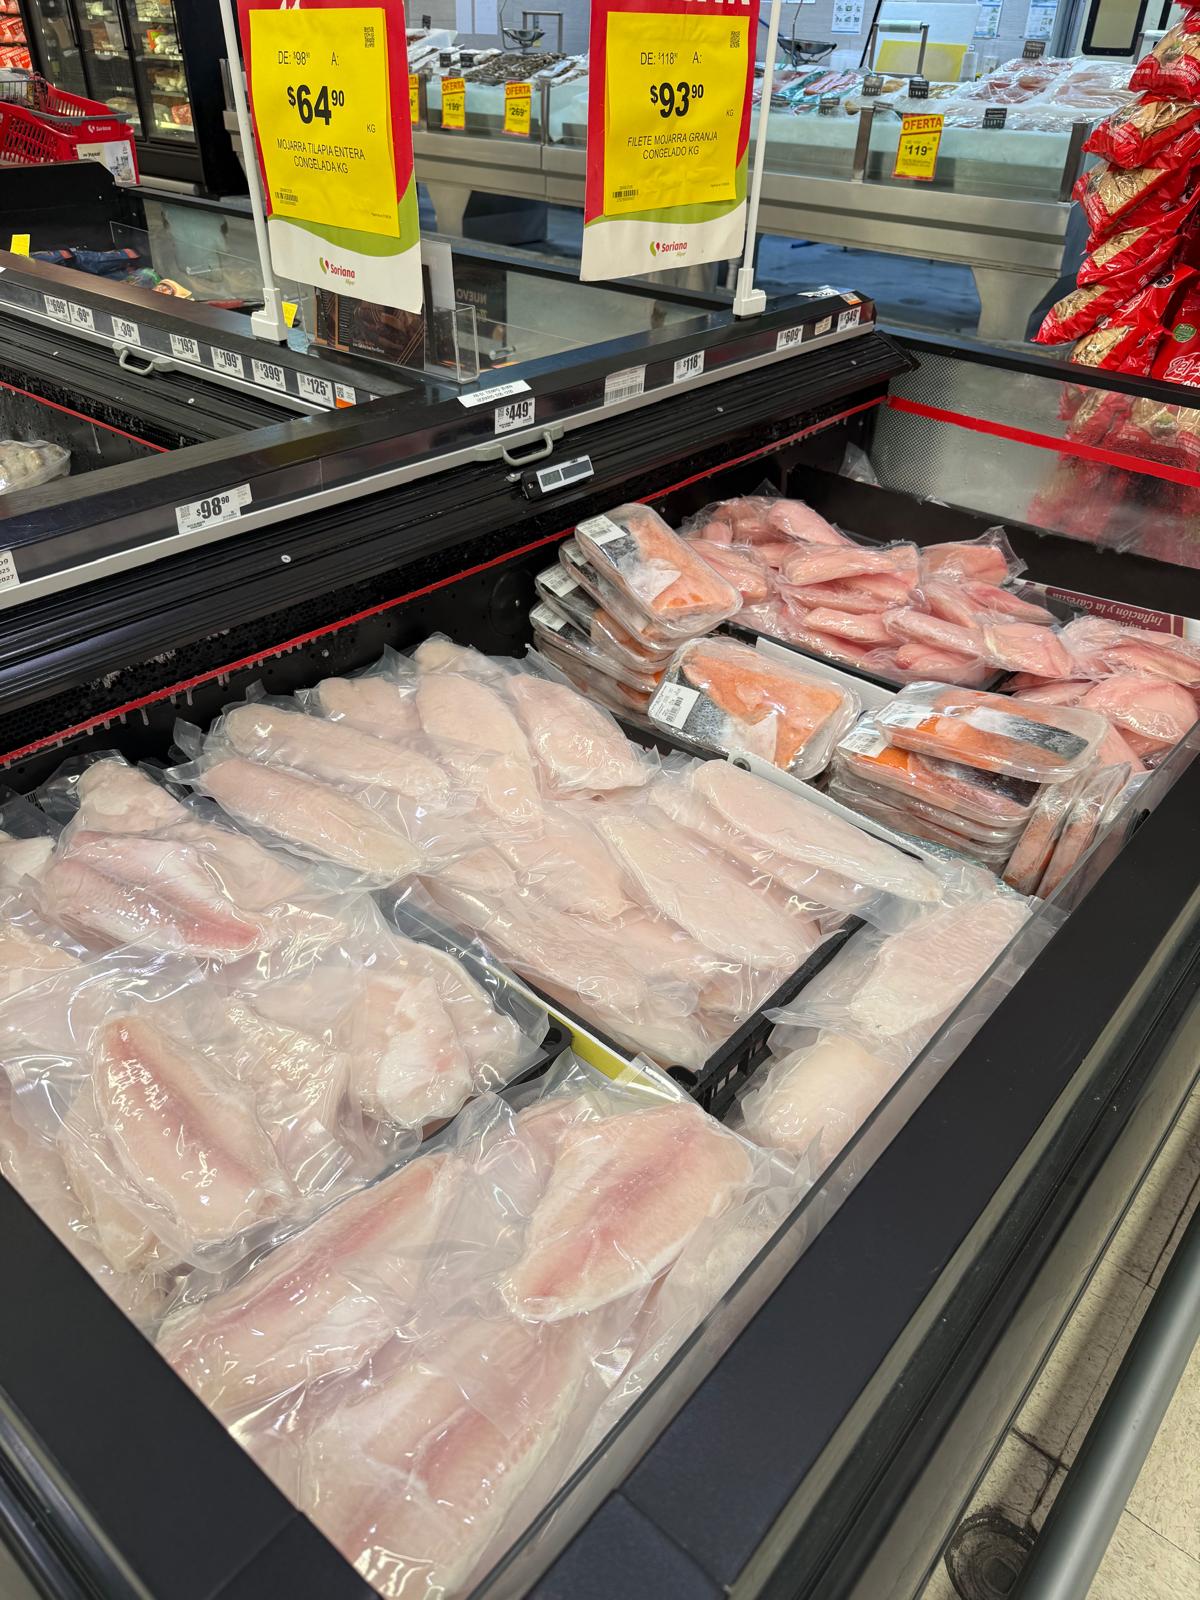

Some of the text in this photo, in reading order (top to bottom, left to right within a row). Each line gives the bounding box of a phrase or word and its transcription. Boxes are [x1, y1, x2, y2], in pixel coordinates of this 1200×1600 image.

[278, 51, 291, 65] DE:
[331, 52, 340, 66] A:
[640, 52, 656, 66] DE:
[692, 52, 702, 64] A:
[442, 81, 465, 92] OFERTA
[505, 85, 531, 96] OFERTA
[726, 108, 734, 117] KG
[366, 124, 376, 133] KG
[903, 116, 942, 131] OFERTA
[628, 131, 718, 147] FILETE MOJARRA GRANJA
[277, 138, 366, 160] MOJARRA TILAPIA ENTERA
[643, 145, 700, 160] CONGELADO KG
[294, 156, 349, 174] CONGELADA KG
[661, 241, 688, 253] Soriana
[330, 263, 356, 279] Soriana
[1095, 602, 1106, 614] la
[1107, 604, 1116, 614] y
[1116, 605, 1164, 627] Inflación
